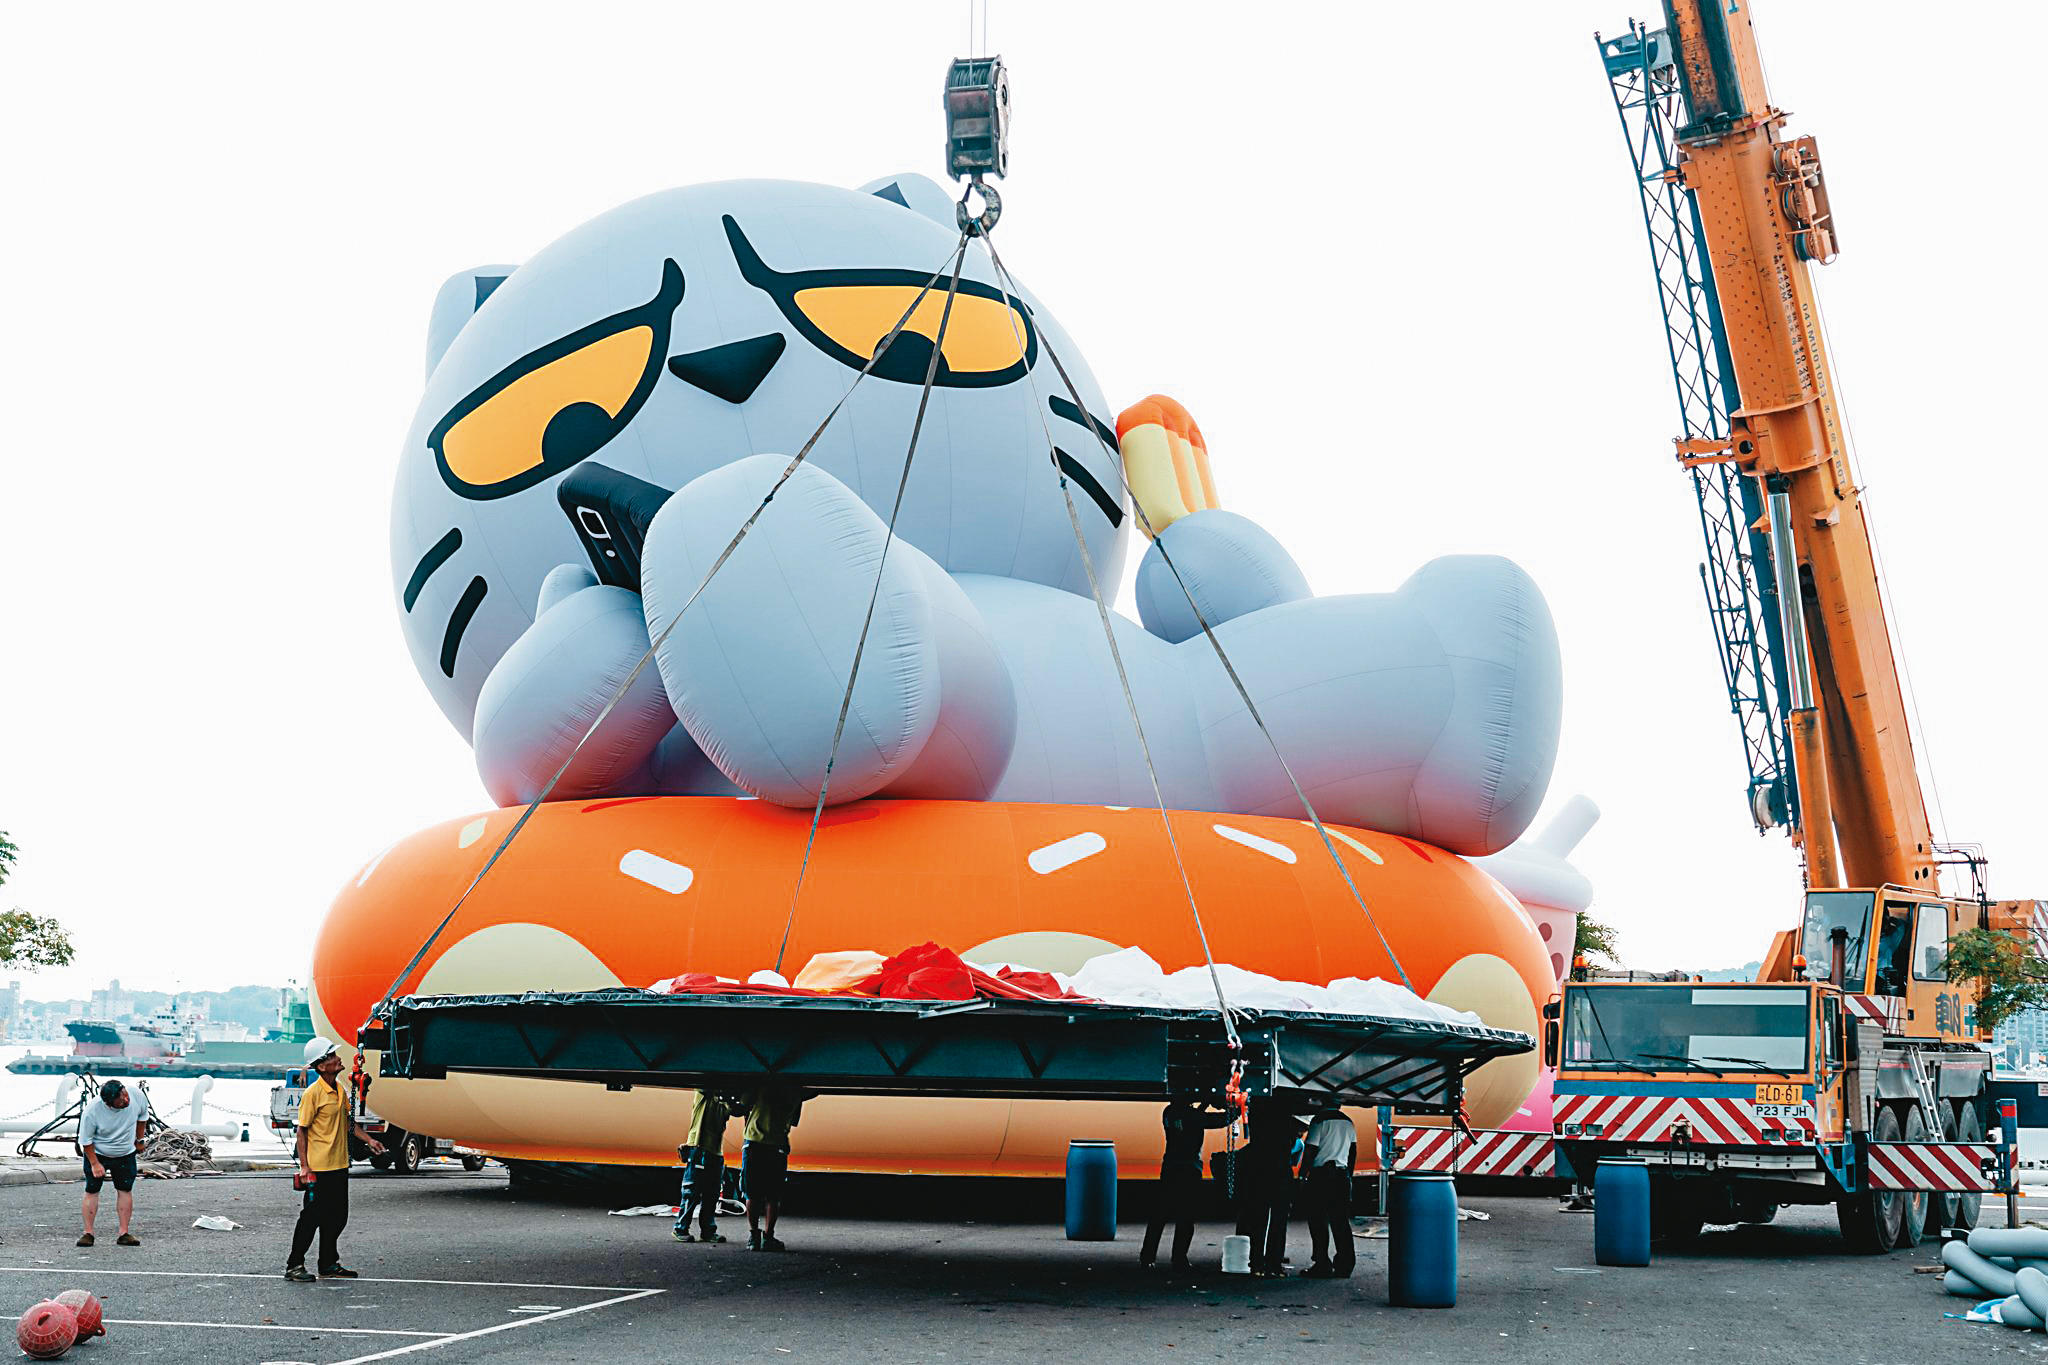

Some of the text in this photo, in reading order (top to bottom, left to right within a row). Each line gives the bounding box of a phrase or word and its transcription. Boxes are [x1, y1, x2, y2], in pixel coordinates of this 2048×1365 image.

[1766, 1087, 1799, 1101] LD-61
[1756, 1106, 1807, 1117] P23 FJH
